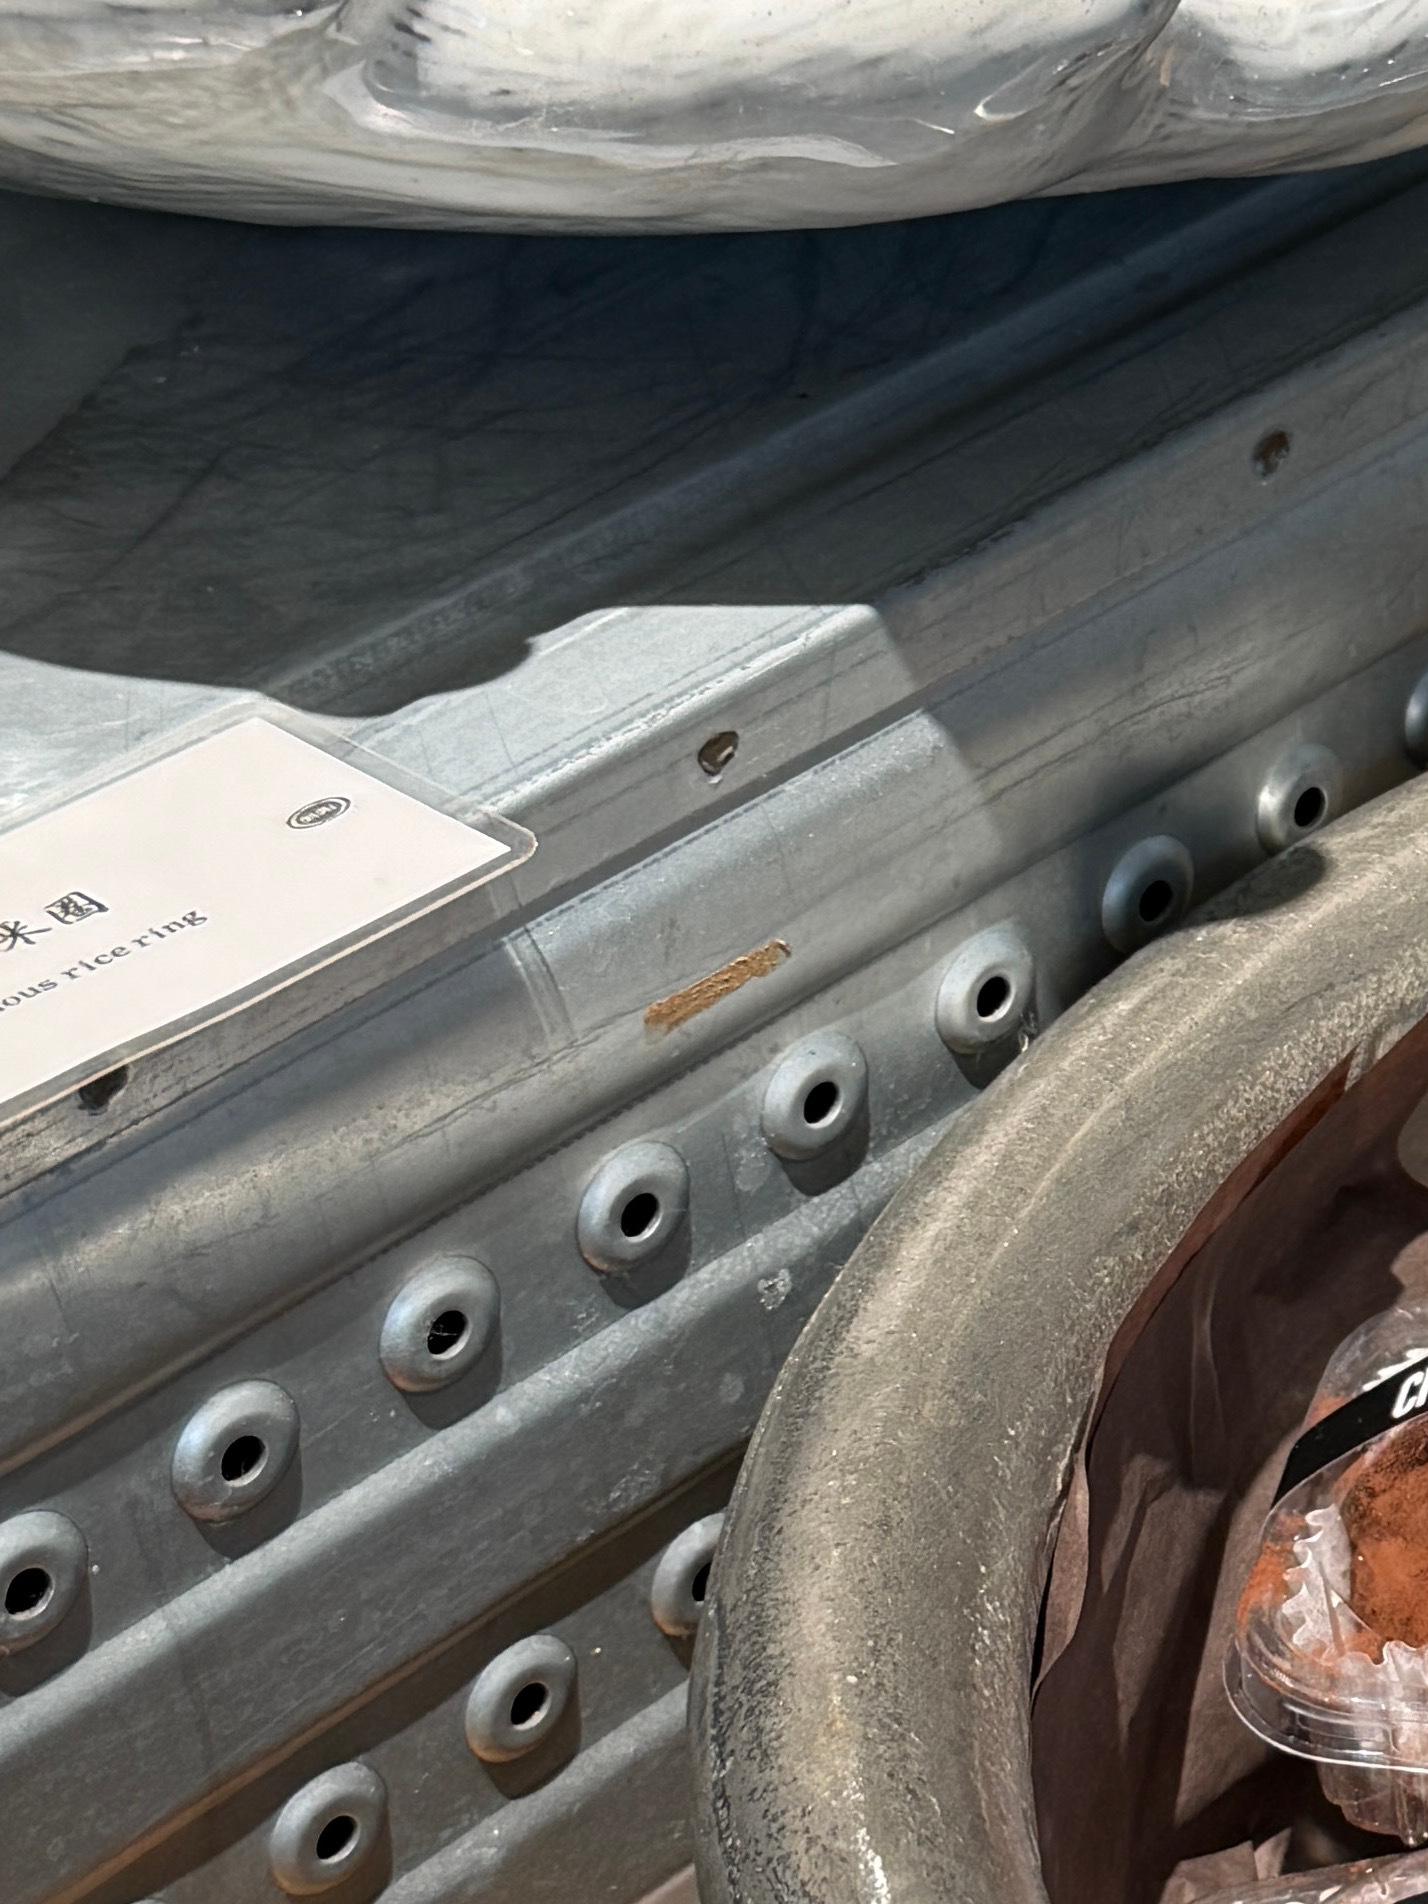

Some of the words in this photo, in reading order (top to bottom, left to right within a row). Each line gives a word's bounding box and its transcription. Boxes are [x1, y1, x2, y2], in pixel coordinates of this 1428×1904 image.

[0, 979, 58, 1012] ous
[61, 946, 131, 979] rice
[131, 910, 208, 947] ring
